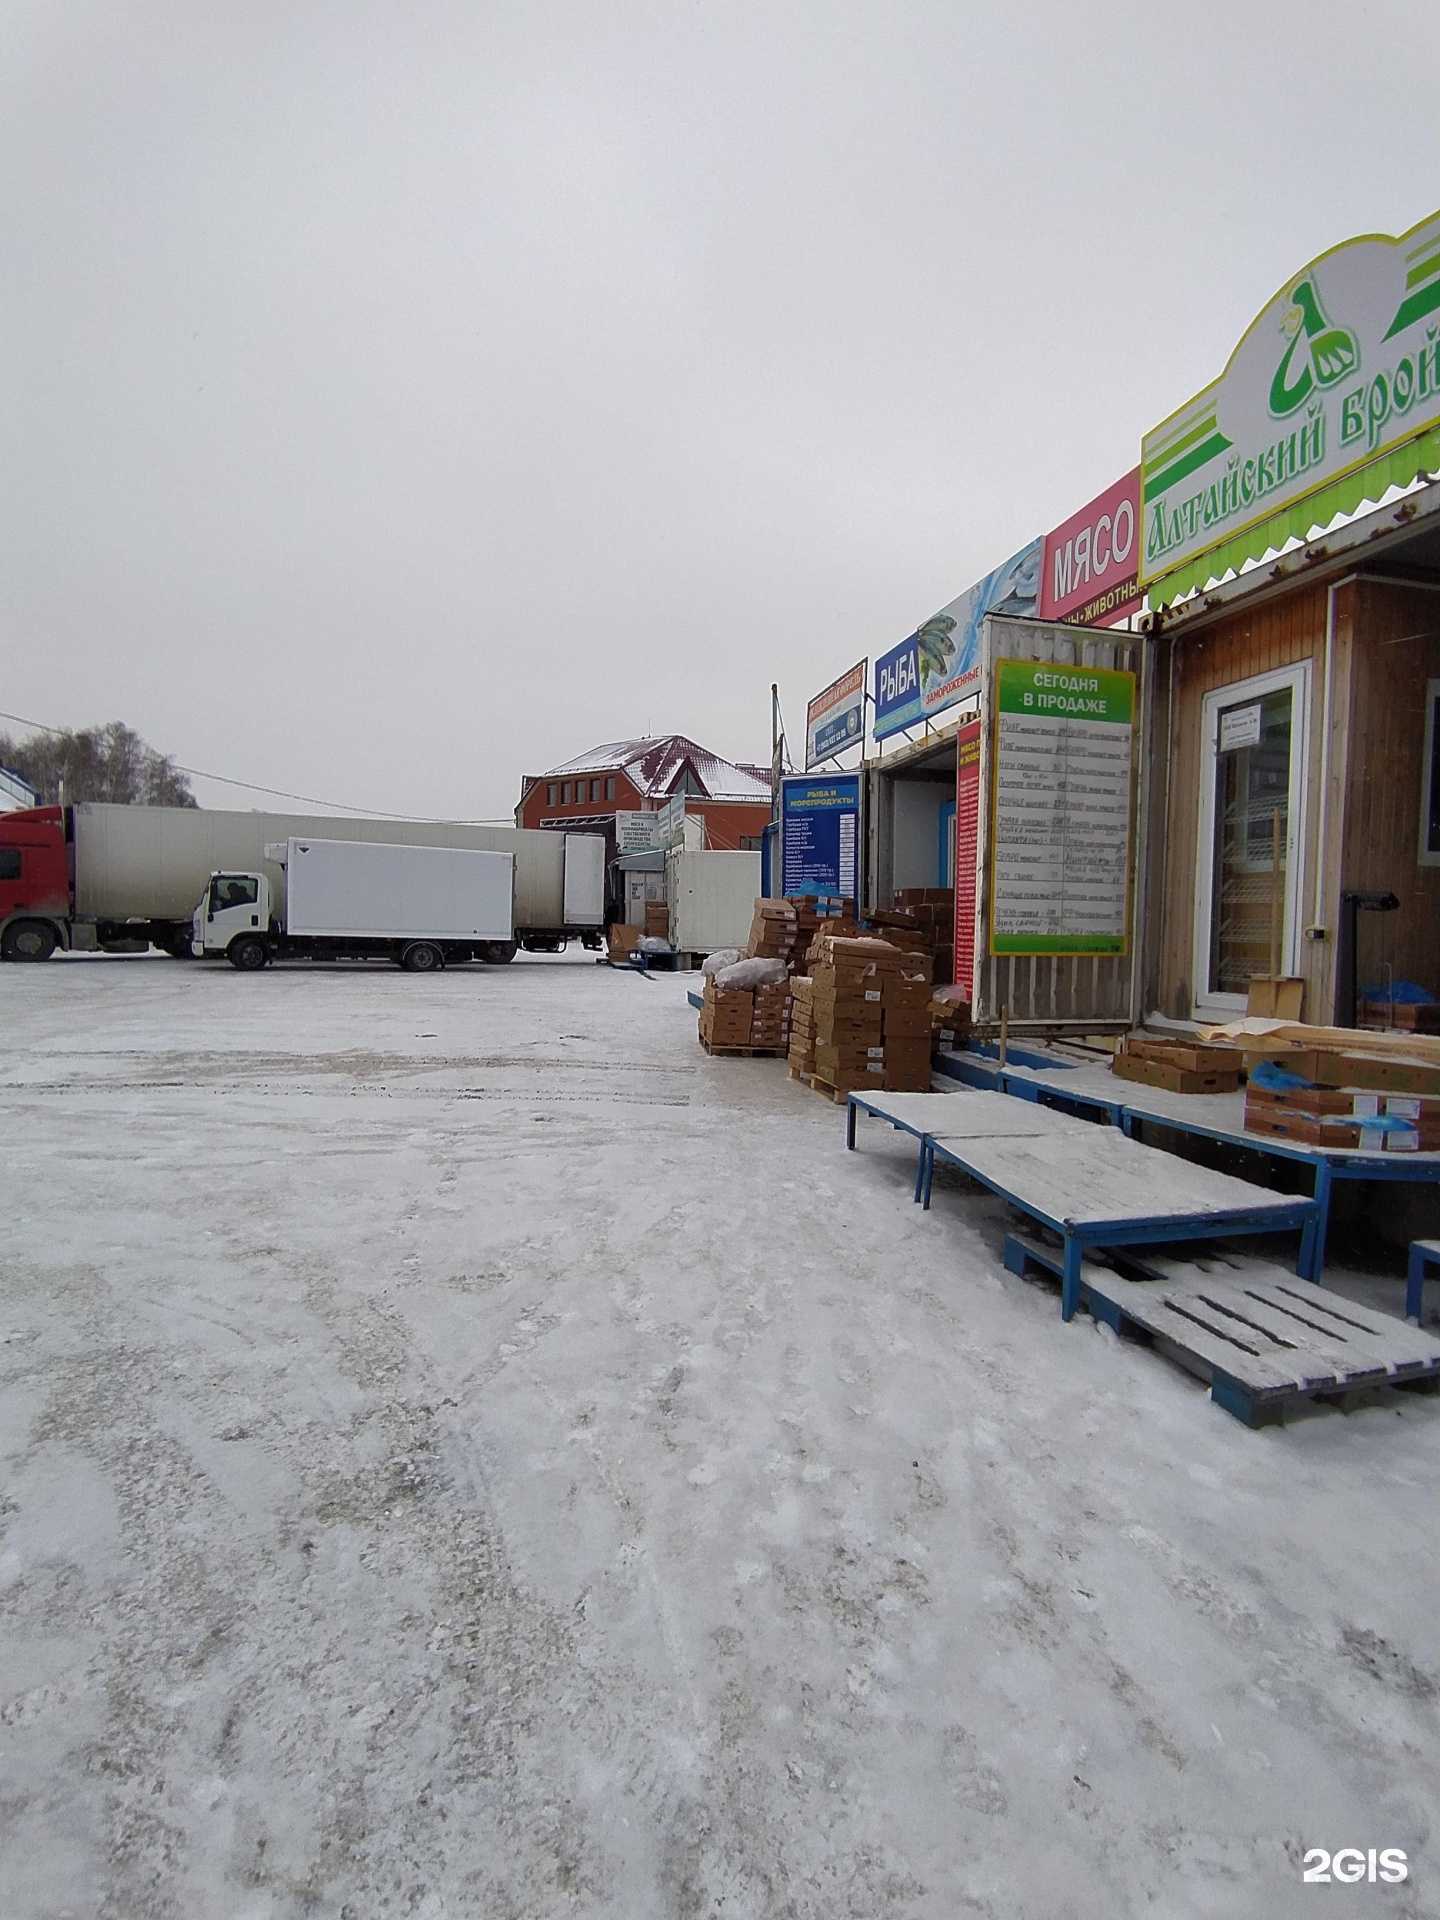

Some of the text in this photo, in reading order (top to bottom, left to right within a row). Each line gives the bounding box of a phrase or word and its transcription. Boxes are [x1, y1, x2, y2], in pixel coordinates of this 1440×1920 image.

[1146, 402, 1326, 558] Алтайский
[1054, 499, 1135, 603] МЯСО
[1083, 579, 1141, 623] ЖИВОТНЫ
[879, 650, 917, 706] РЫБА
[1023, 692, 1107, 714] В ПРОДАЖЕ
[1033, 672, 1099, 692] СЕГОДНЯ
